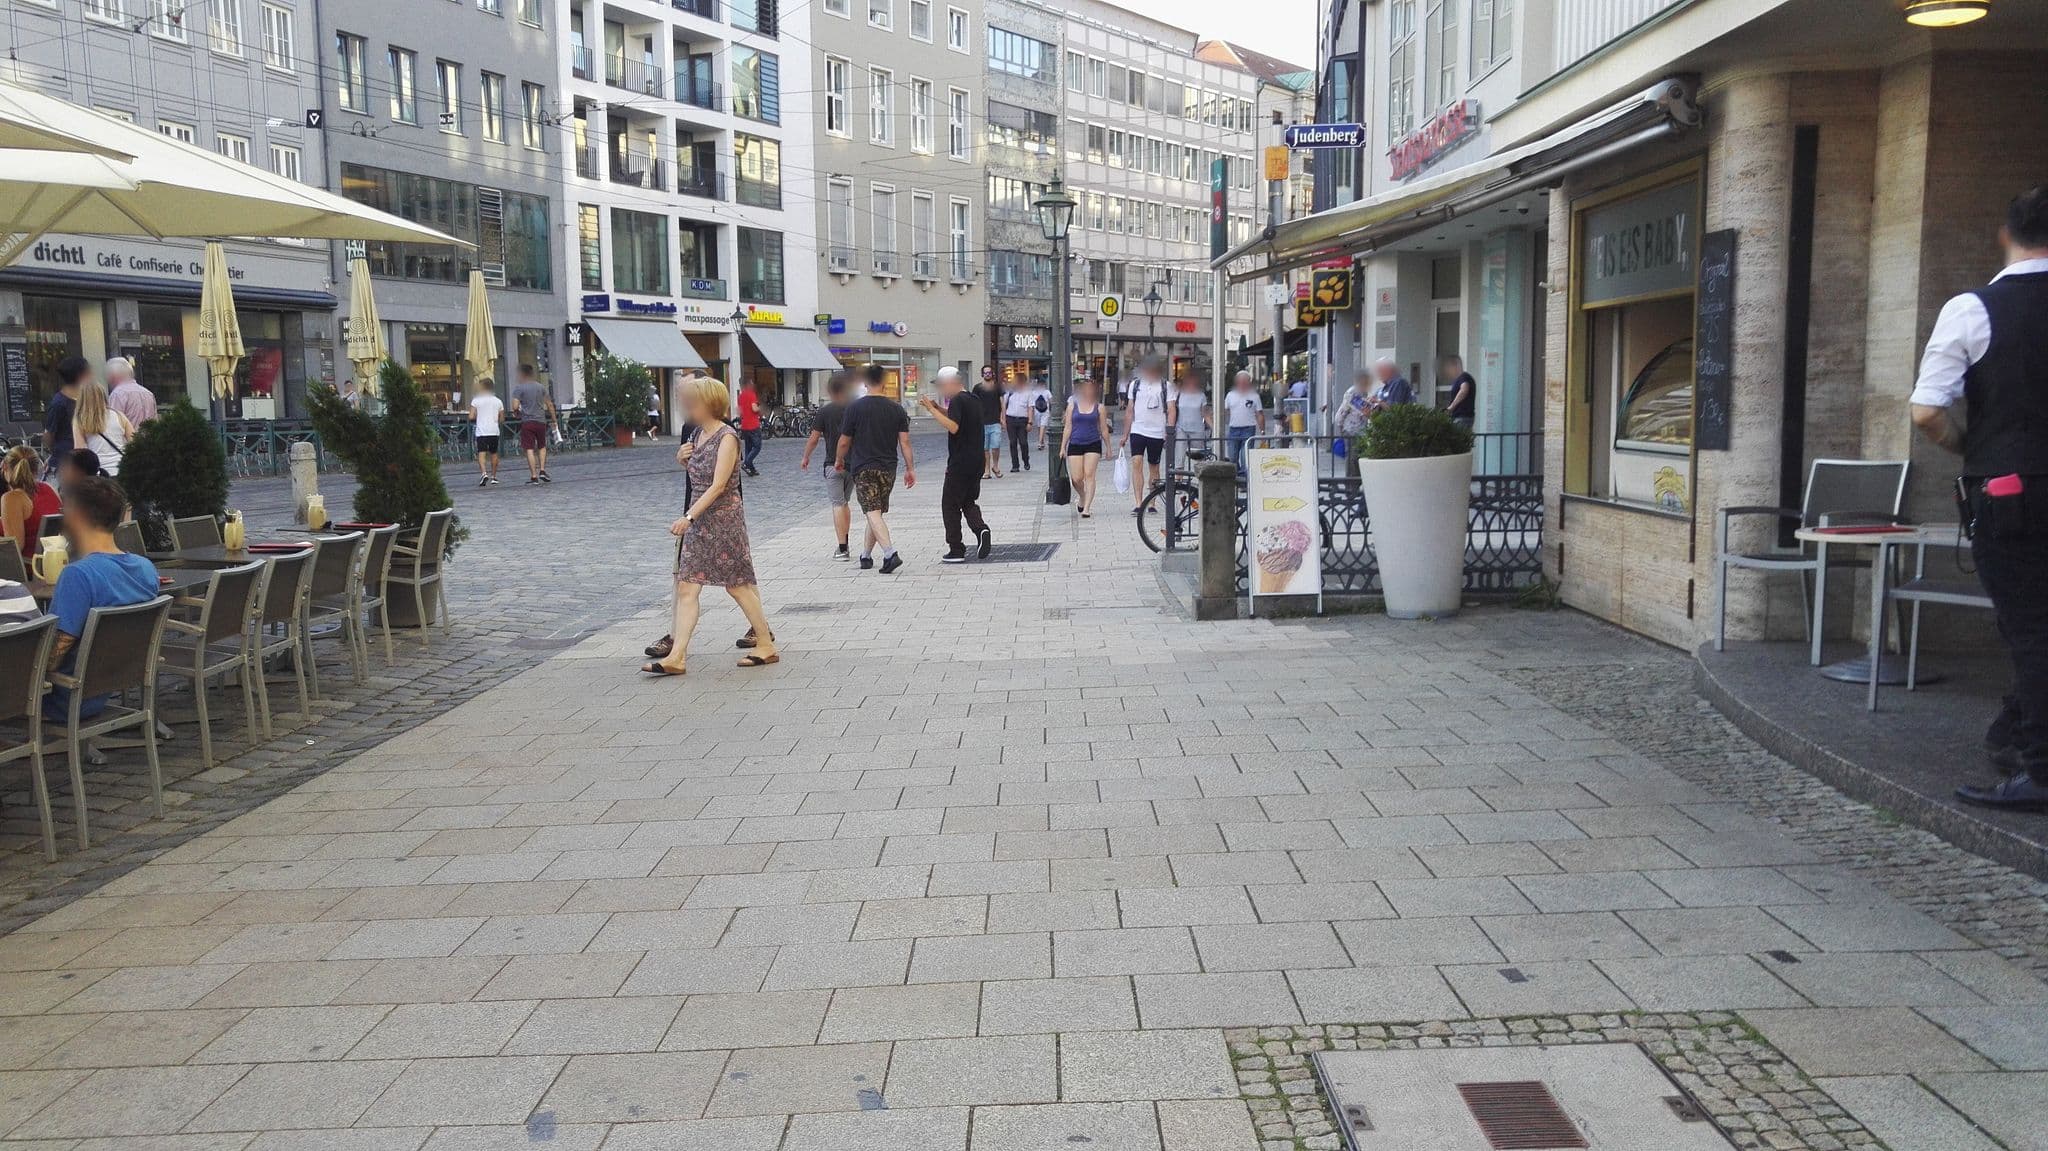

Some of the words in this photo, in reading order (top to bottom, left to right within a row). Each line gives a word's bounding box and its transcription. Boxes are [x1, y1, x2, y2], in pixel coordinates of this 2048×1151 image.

[1293, 128, 1358, 147] Judenberg
[34, 242, 85, 265] dichtl
[97, 252, 122, 268] Café
[129, 255, 183, 274] Confiserie
[190, 258, 244, 279] Chtier
[1106, 302, 1114, 314] H
[684, 314, 729, 326] maxpassage
[1014, 334, 1038, 351] snipes
